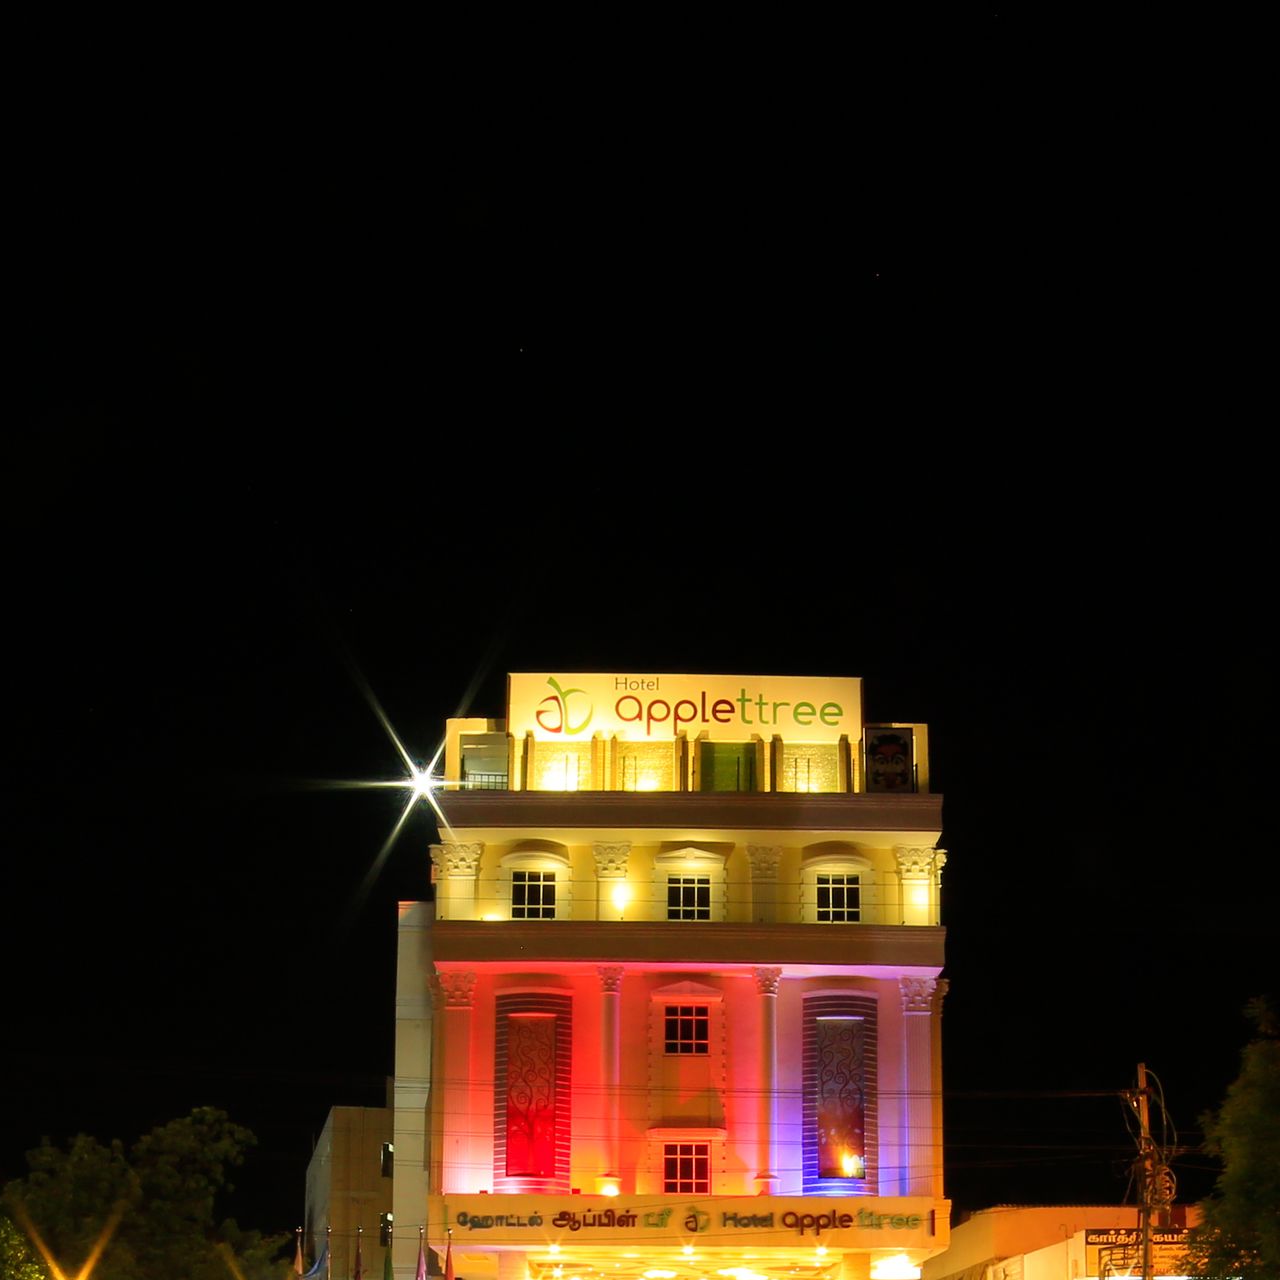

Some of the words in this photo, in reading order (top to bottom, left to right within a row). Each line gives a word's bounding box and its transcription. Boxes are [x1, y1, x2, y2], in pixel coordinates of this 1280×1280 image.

[615, 677, 659, 691] Hotel
[457, 1211, 543, 1231] ஹோட்டல்
[552, 1208, 638, 1231] ஆப்பிள்
[721, 1210, 774, 1229] Hotel
